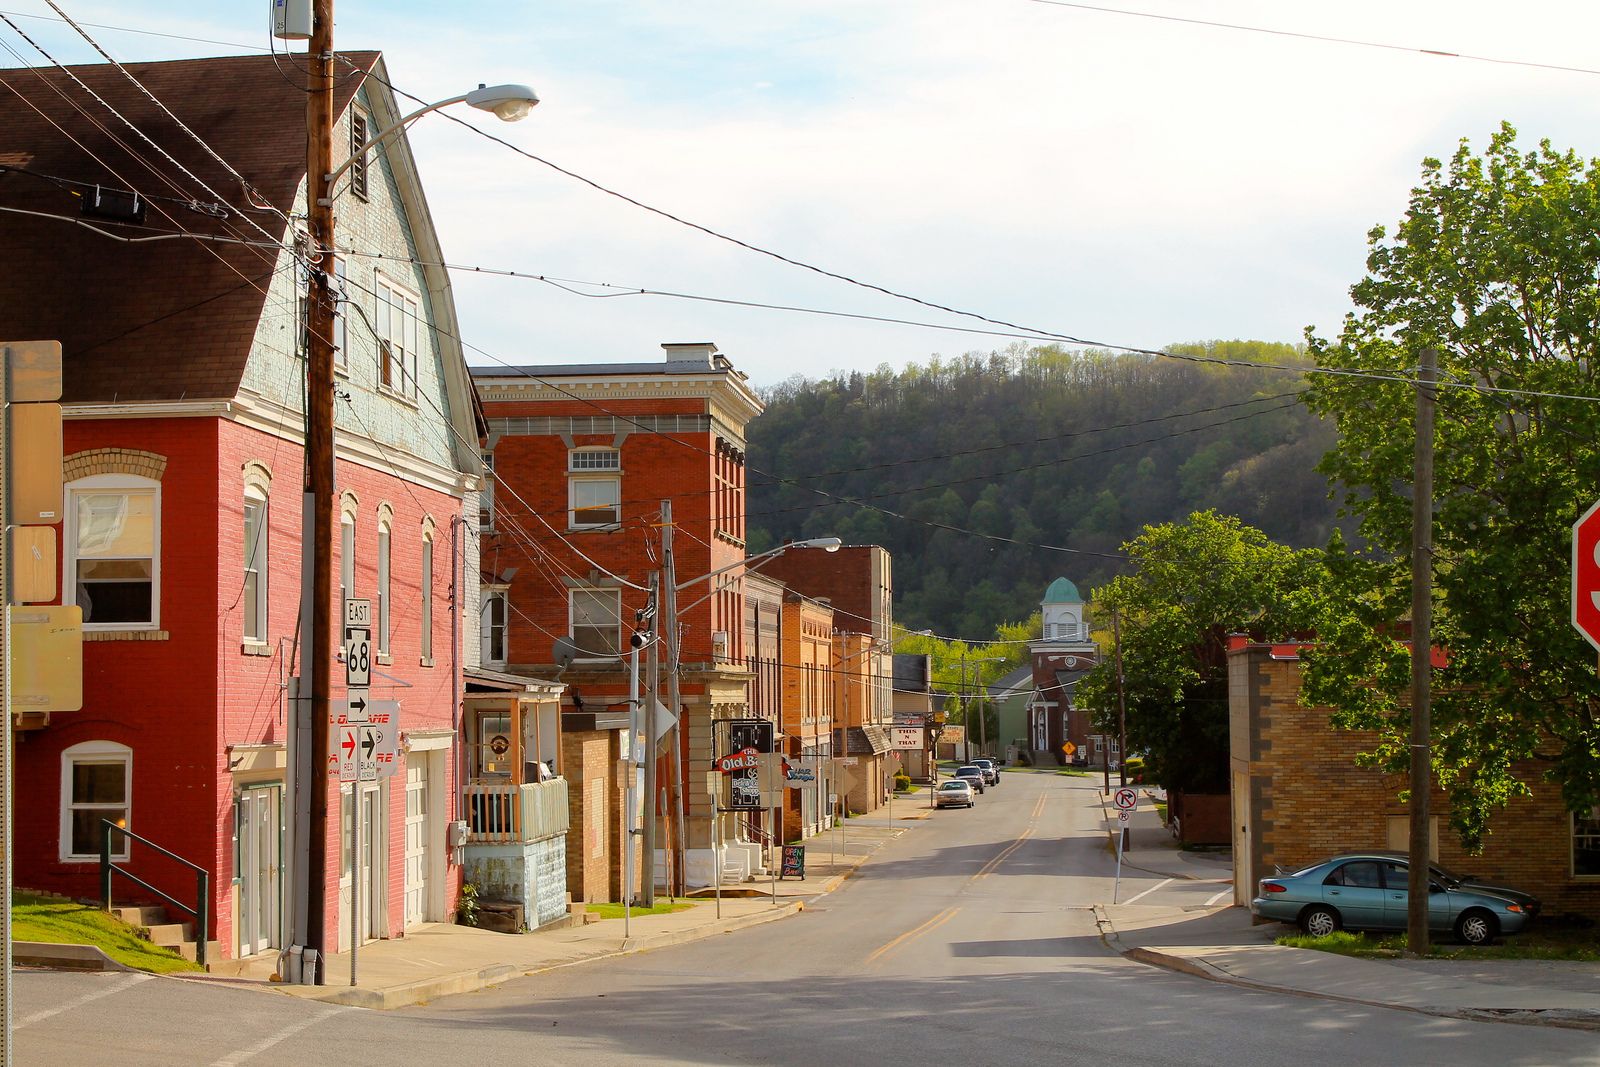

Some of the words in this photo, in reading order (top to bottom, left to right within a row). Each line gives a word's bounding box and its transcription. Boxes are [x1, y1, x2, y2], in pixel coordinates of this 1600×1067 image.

[349, 603, 367, 620] EAST
[350, 642, 368, 672] 68
[344, 762, 354, 771] RED
[361, 761, 375, 770] BLACK
[722, 757, 743, 771] Old
[785, 847, 803, 856] OPEN
